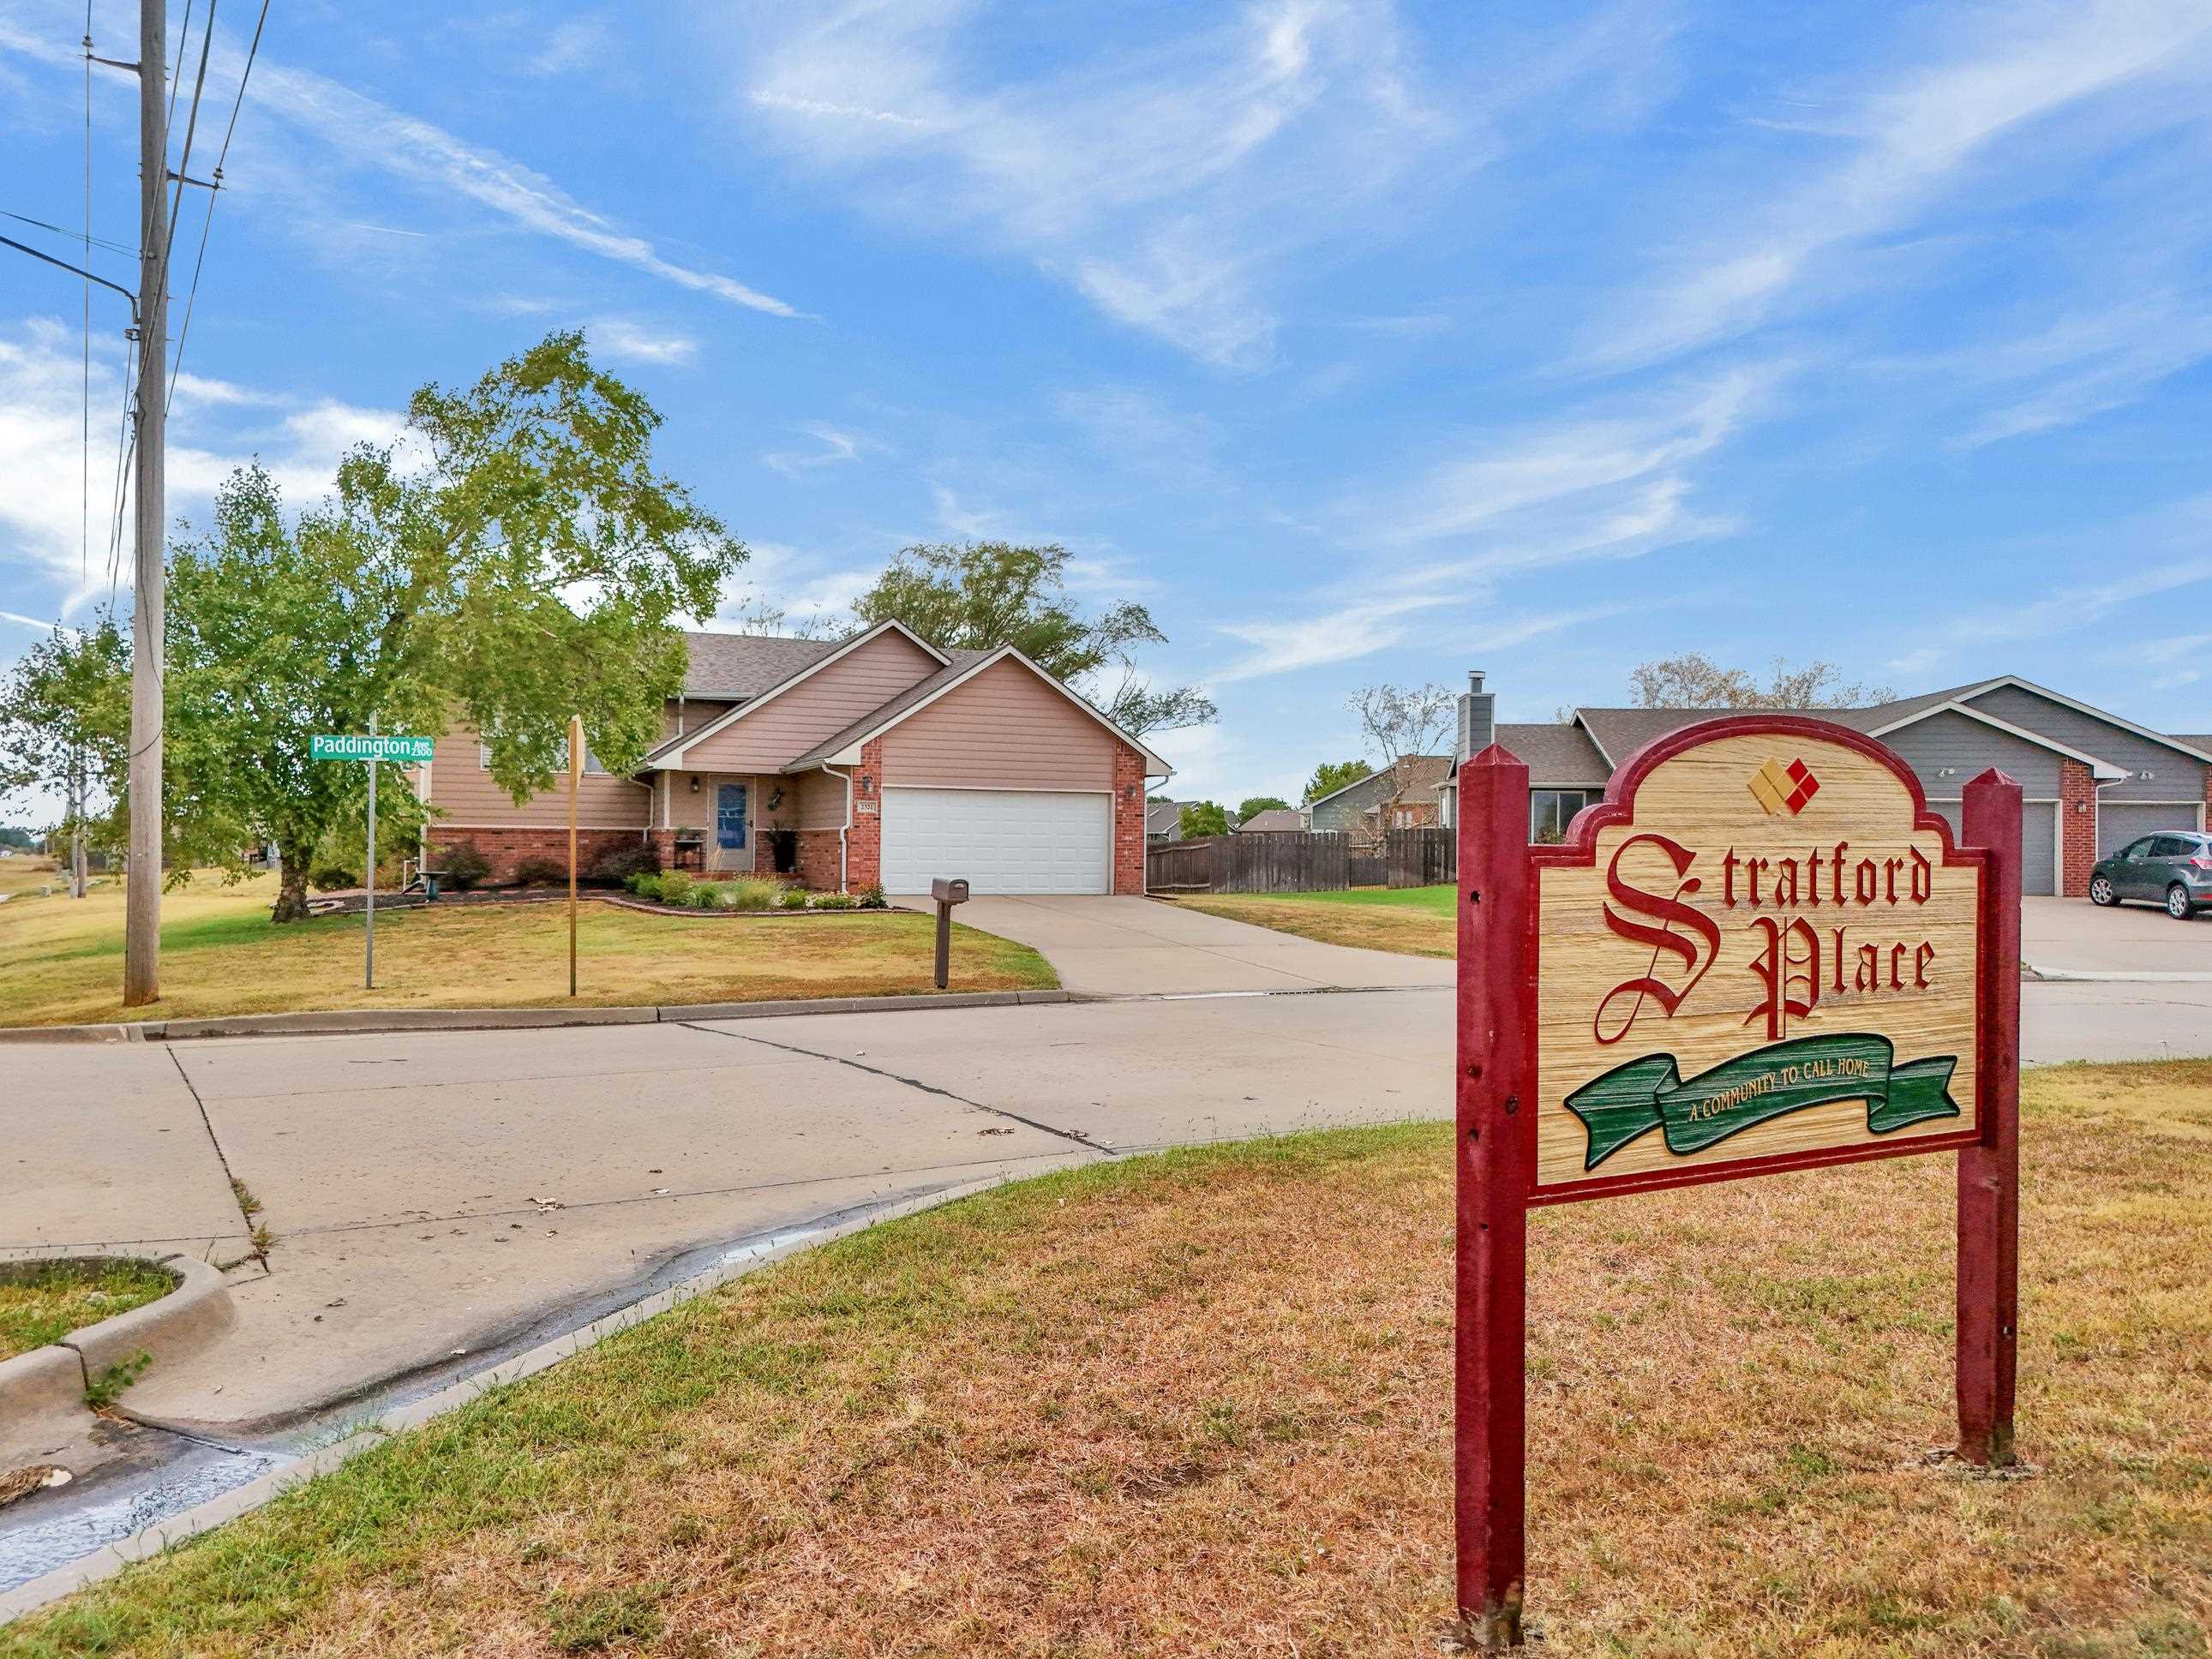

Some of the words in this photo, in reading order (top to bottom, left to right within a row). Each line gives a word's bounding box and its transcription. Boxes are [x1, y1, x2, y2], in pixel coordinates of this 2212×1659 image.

[314, 736, 411, 757] Paddington
[1594, 833, 1932, 1045] Stratford
[1743, 916, 1936, 1040] Place
[1689, 1103, 1699, 1121] A
[1702, 1073, 1777, 1117] COMMUNITY
[1781, 1066, 1799, 1086] TO
[1803, 1060, 1833, 1080] CALL
[1838, 1059, 1870, 1077] HOME
